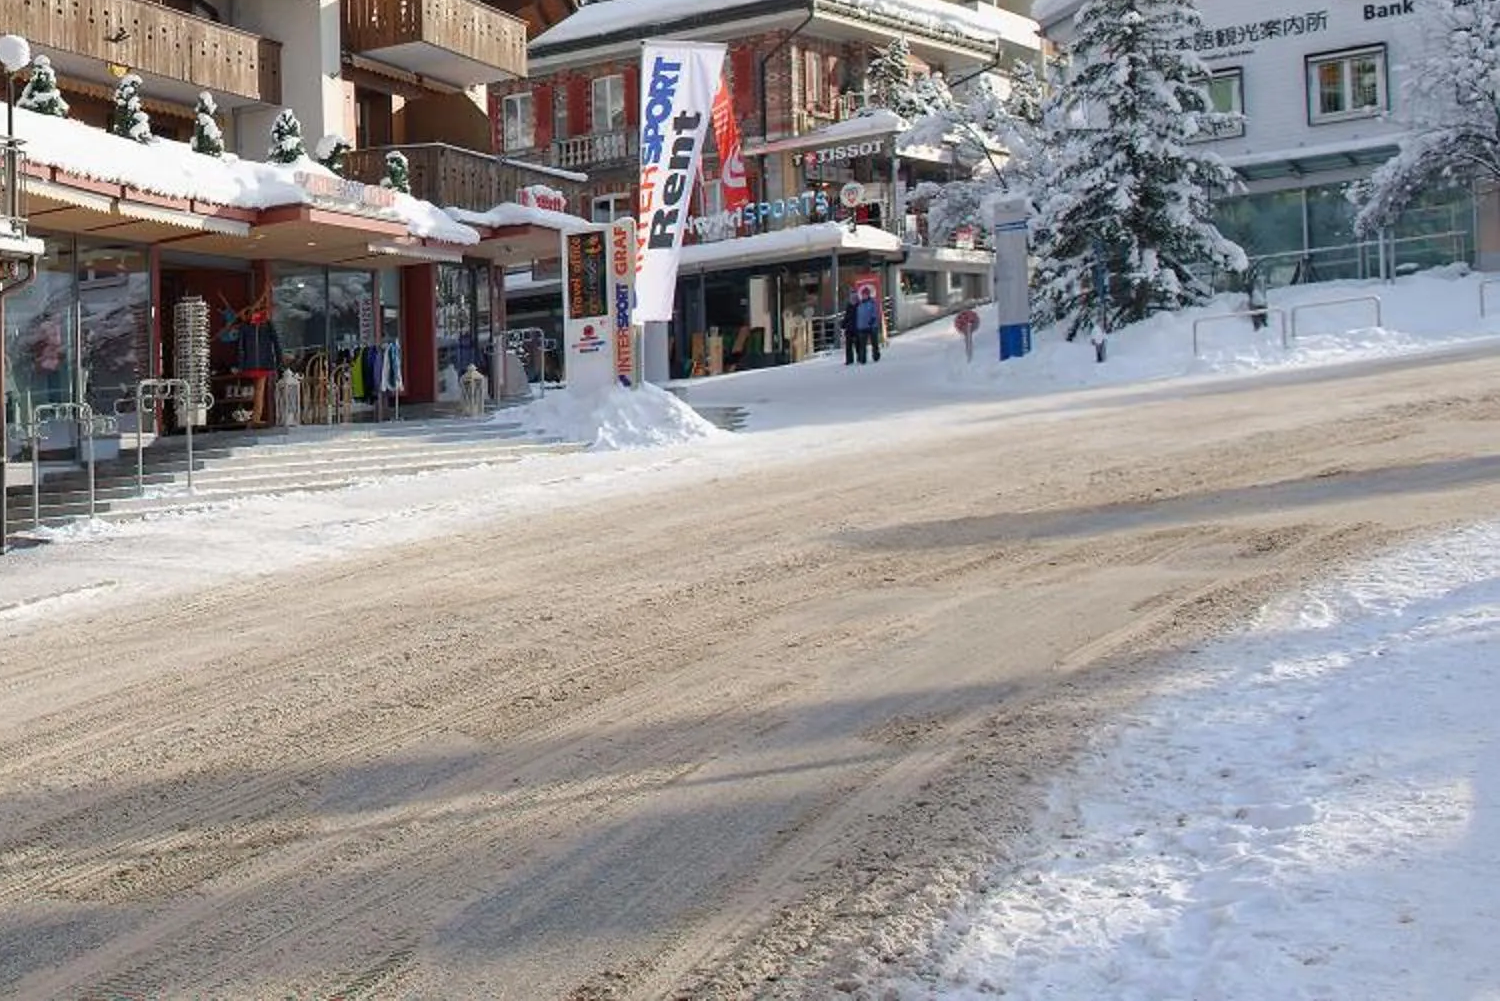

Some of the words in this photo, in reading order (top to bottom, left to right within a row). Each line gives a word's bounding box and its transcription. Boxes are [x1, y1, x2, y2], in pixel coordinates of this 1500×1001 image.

[817, 139, 885, 165] TISSOT
[648, 110, 701, 249] Rent
[613, 226, 629, 276] GRAF
[570, 278, 584, 319] Travel
[615, 282, 632, 375] INTERSPORT
